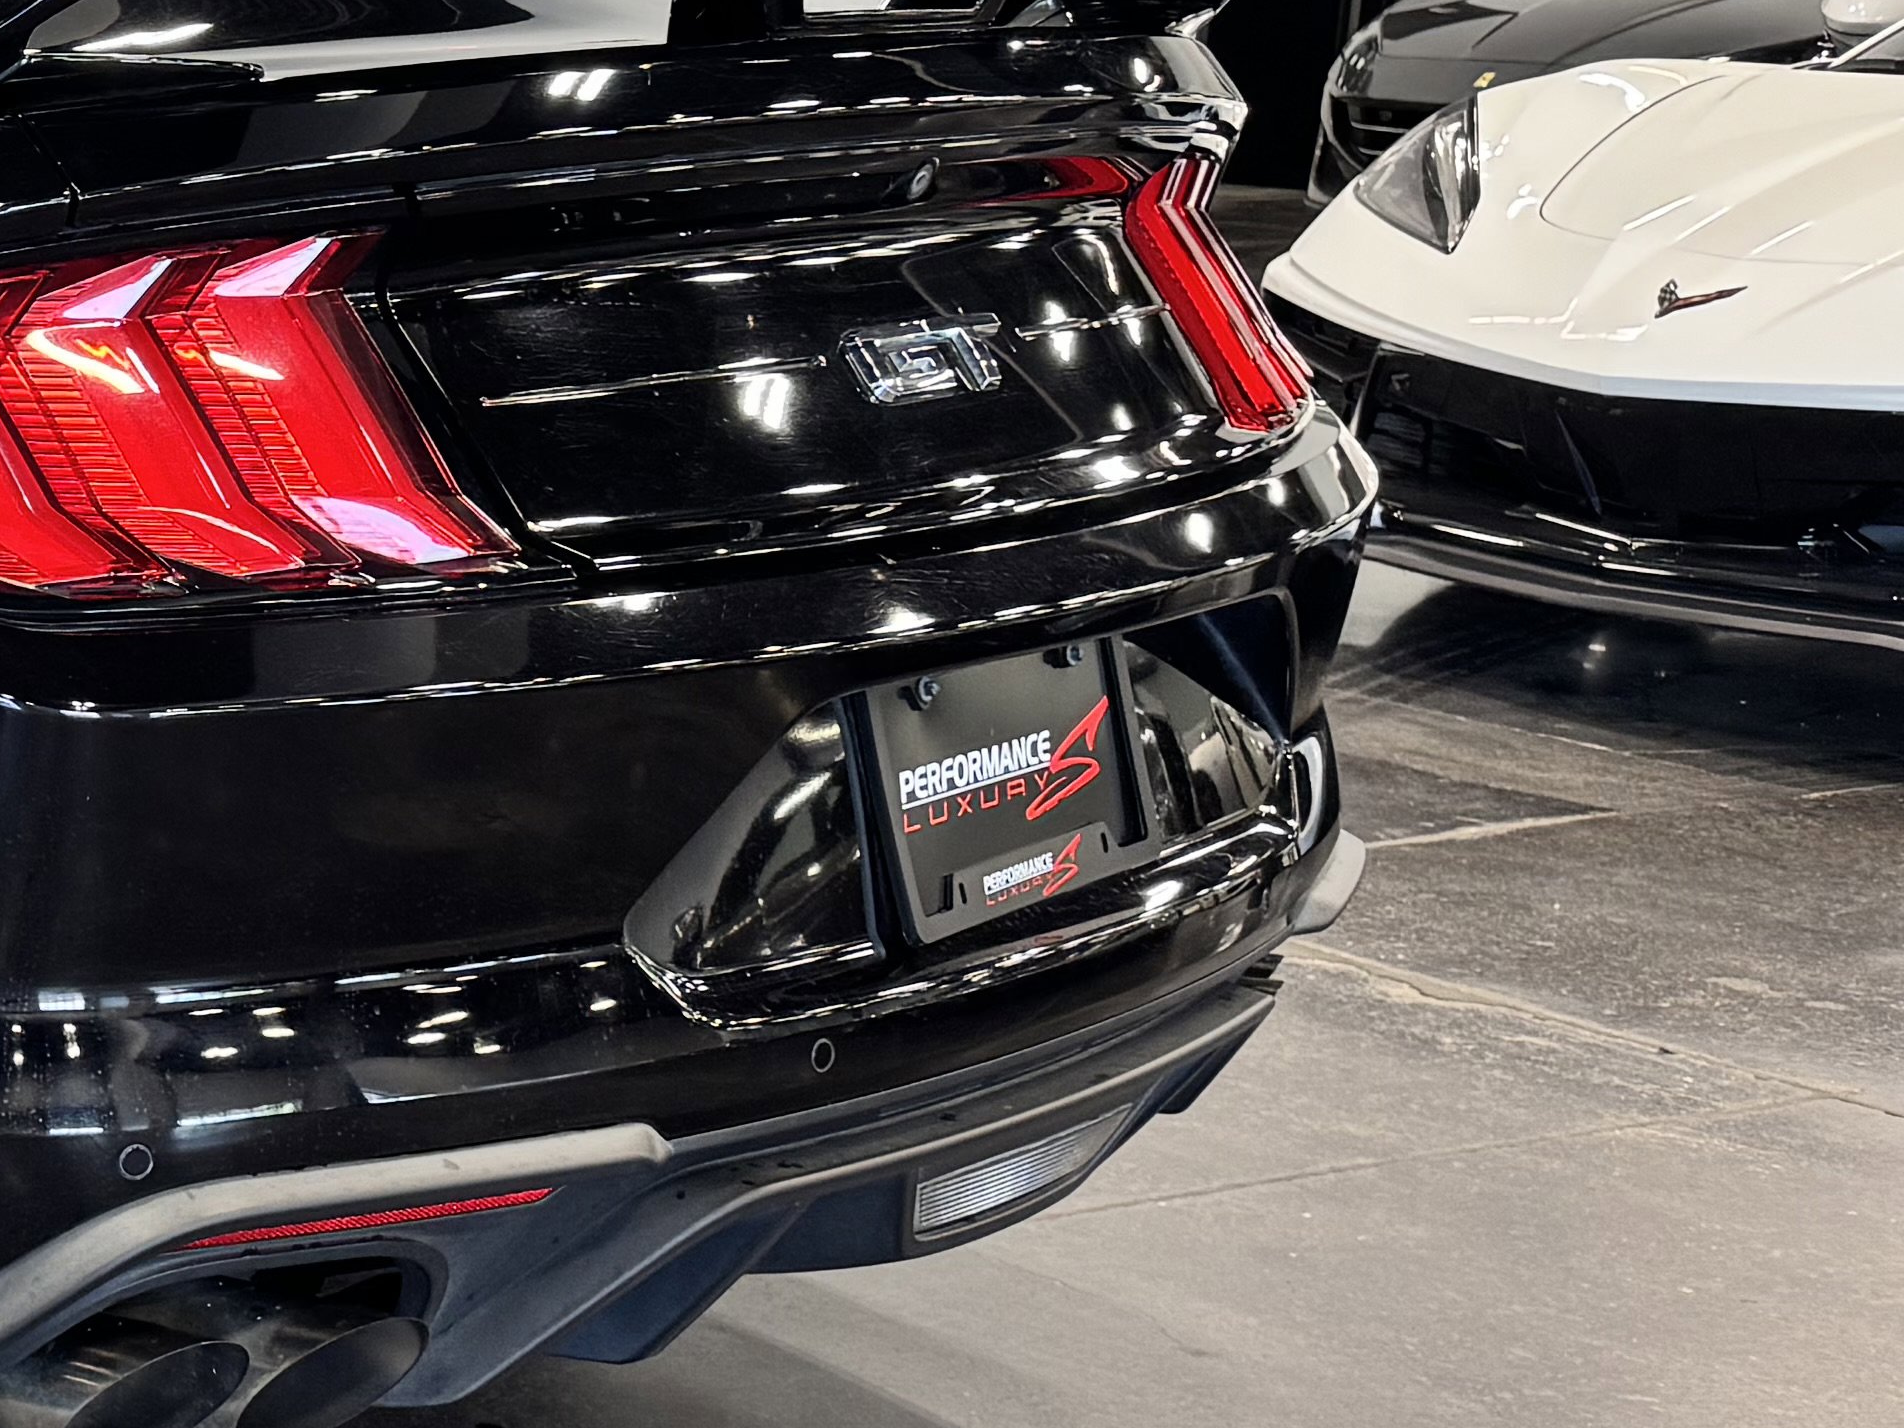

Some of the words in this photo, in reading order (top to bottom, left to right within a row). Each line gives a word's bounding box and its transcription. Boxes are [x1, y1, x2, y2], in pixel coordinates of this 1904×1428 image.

[899, 730, 1051, 804] PERFORMANCE
[903, 771, 1050, 834] LUXURY
[983, 852, 1053, 893] PERFORMANCE
